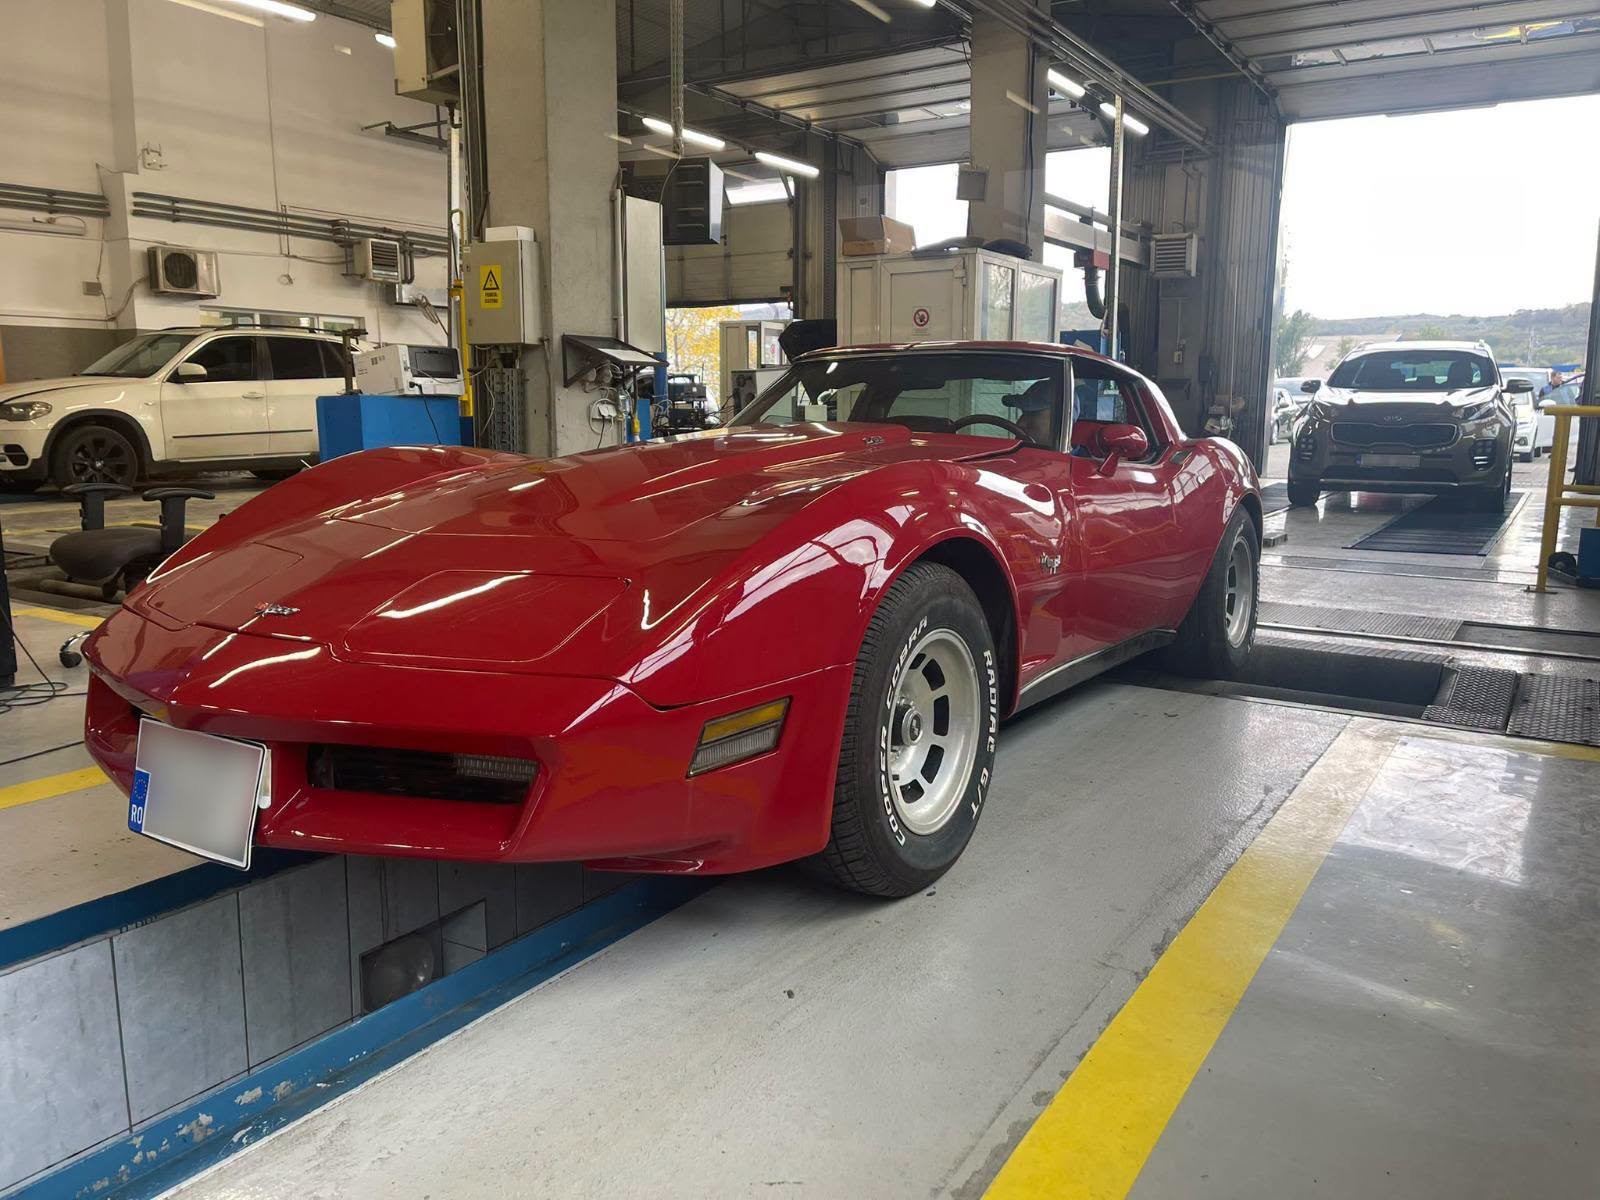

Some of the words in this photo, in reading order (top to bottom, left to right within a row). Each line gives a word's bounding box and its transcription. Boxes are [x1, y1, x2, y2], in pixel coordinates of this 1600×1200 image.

[886, 615, 928, 710] COBRA
[983, 649, 998, 753] RADIAL
[131, 804, 143, 825] RO
[880, 725, 906, 848] COOPER
[970, 767, 989, 820] G/T
